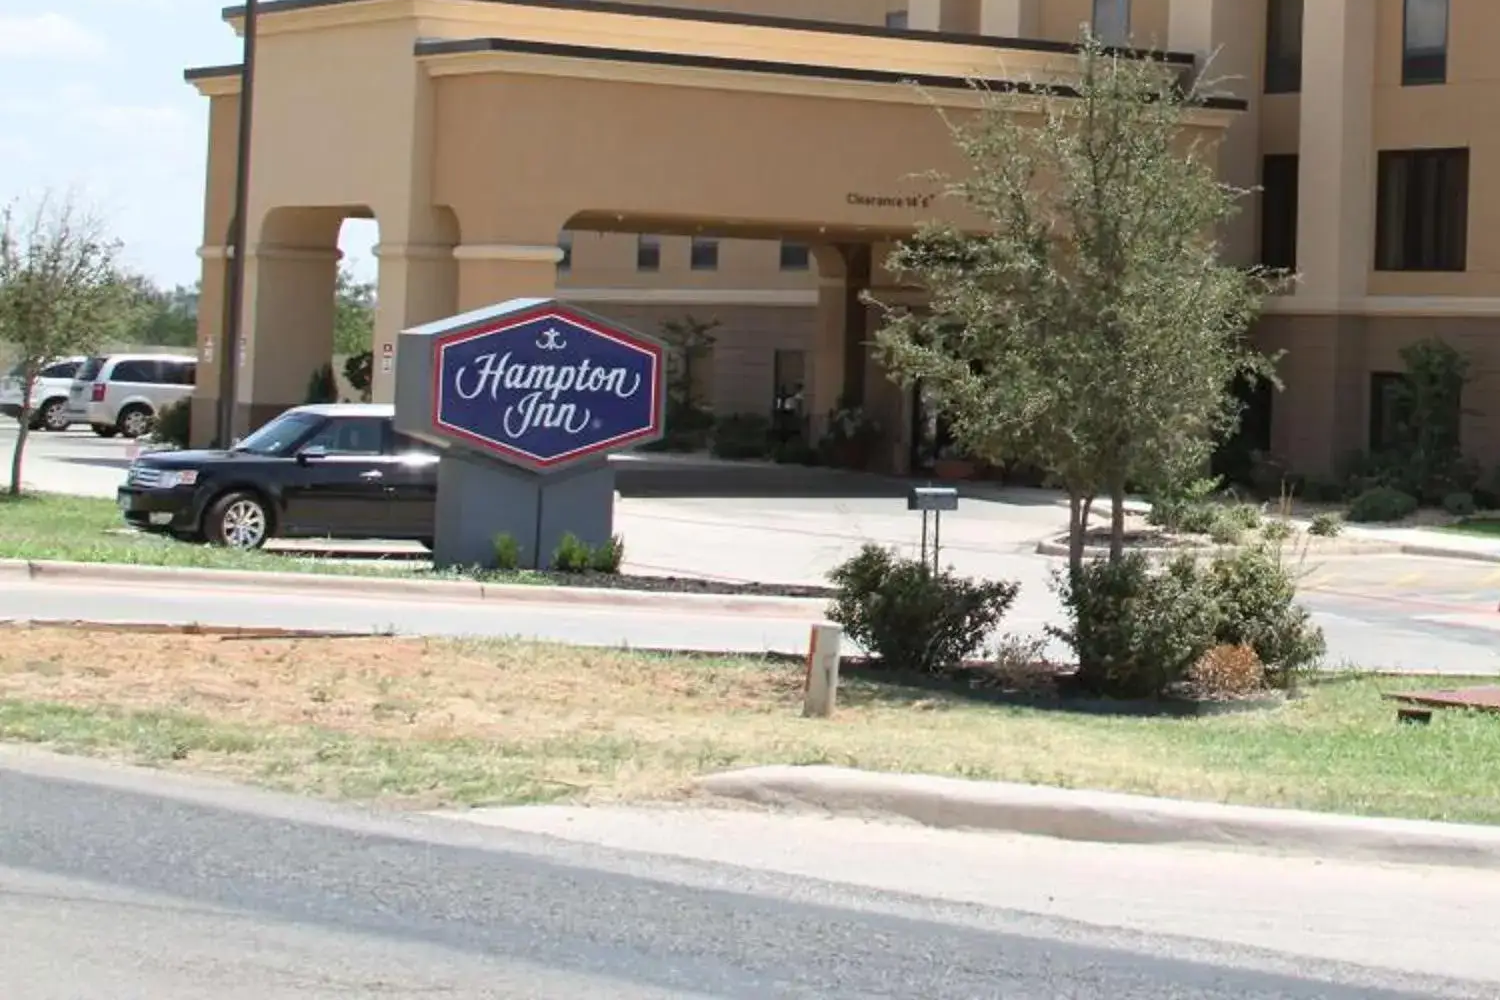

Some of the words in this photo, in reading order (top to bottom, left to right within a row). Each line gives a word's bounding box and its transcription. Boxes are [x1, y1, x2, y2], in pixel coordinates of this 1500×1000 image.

[846, 192, 903, 208] Clearance
[455, 351, 642, 400] Hampton
[503, 391, 591, 439] Inn
